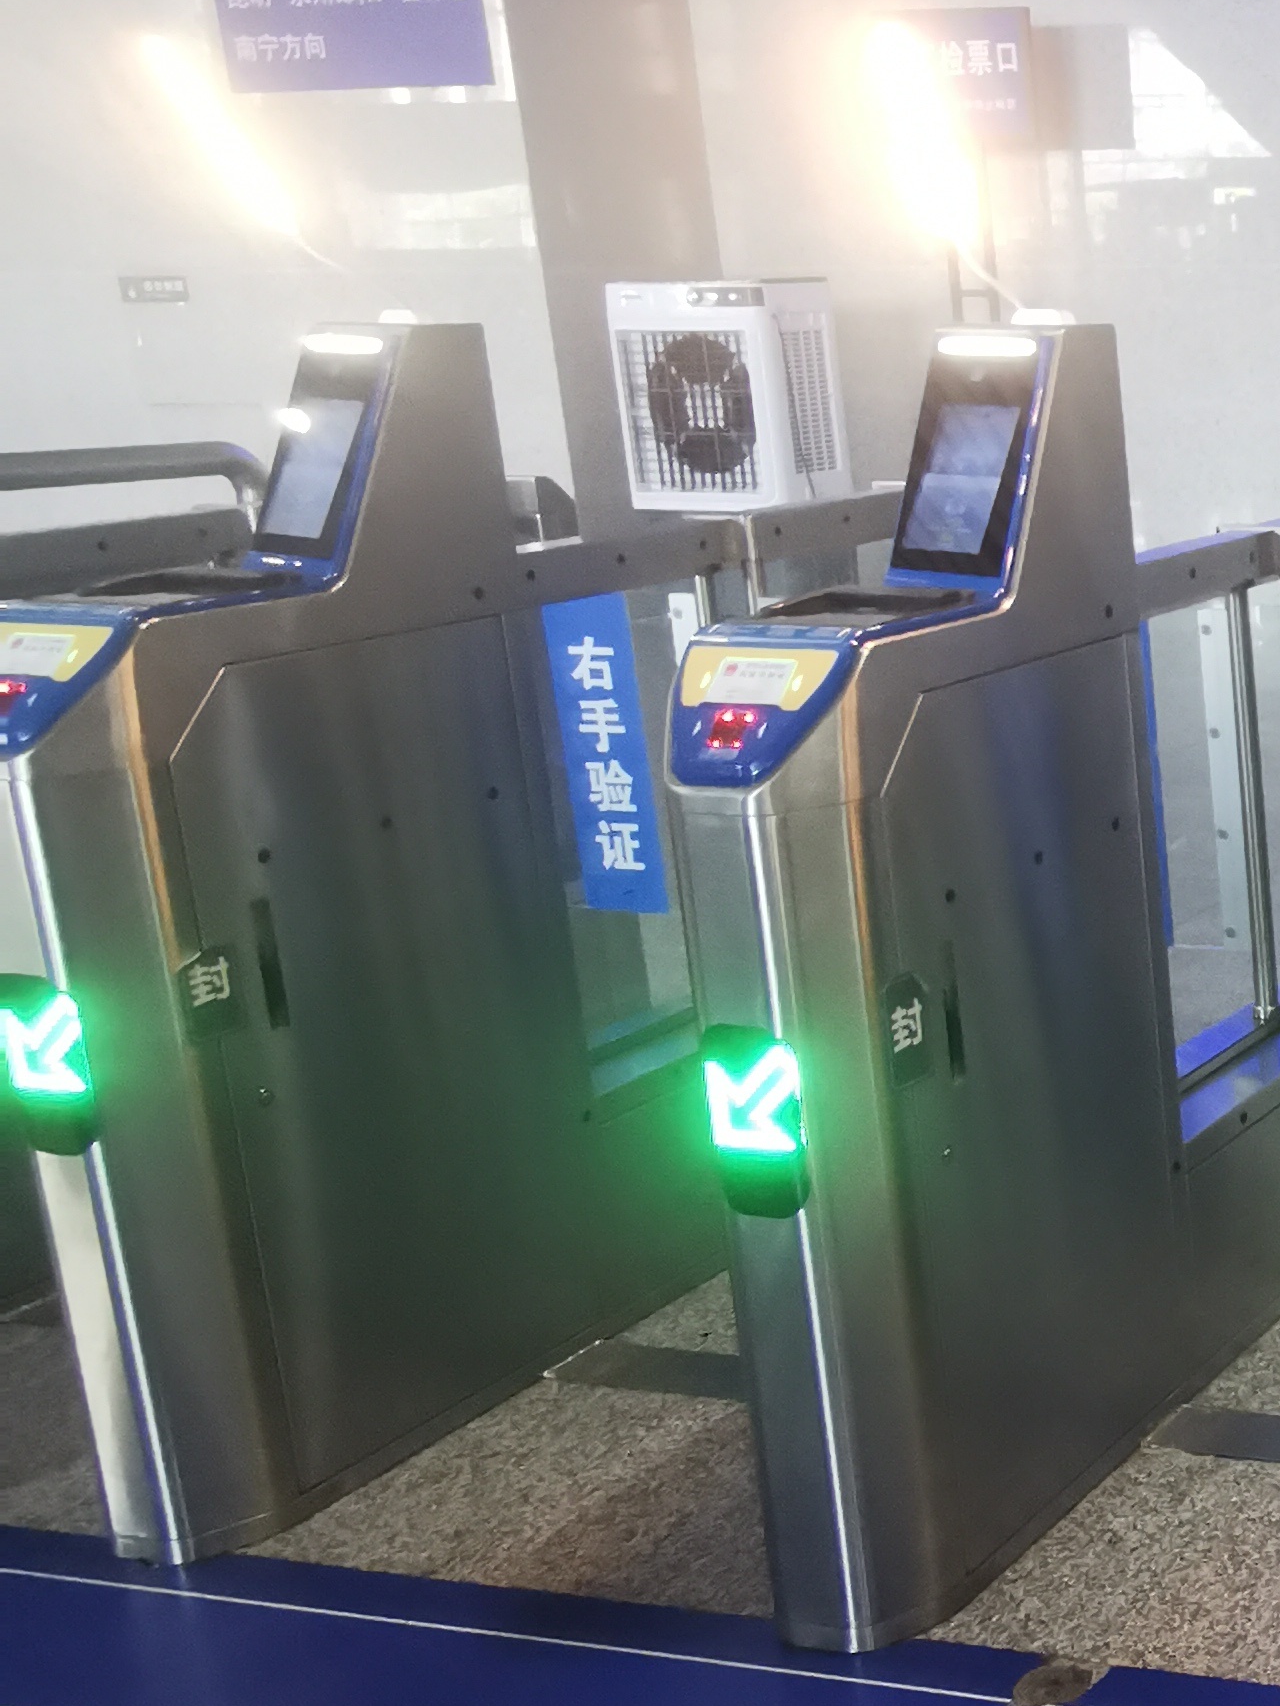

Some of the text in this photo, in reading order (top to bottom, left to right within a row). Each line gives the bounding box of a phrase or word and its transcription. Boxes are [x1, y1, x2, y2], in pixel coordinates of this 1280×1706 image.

[235, 32, 327, 62] 南宁方向
[567, 636, 646, 871] 右手验证
[188, 956, 230, 1007] 封
[891, 997, 922, 1053] 封
